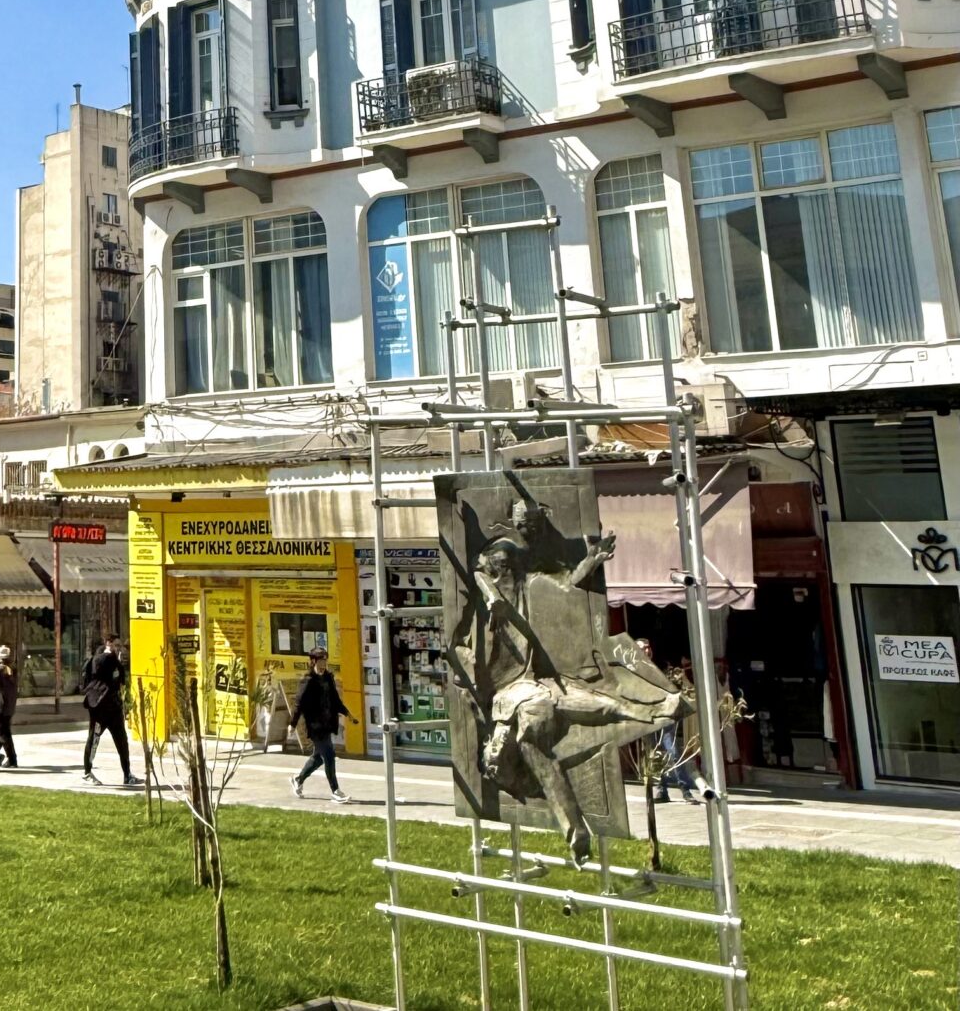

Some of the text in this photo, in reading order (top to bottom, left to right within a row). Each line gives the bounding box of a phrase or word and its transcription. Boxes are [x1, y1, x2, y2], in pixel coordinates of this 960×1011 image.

[181, 520, 272, 535] ΕΝΕΧΥΡΟΔΑΝΕΙ
[168, 540, 232, 555] ΚΕΝΤΡΙΚΗΣ
[236, 541, 331, 556] ΘΕΣΣΑΛΟΝΙΚΗΣ
[904, 640, 947, 650] MEA
[901, 649, 953, 659] CUPA
